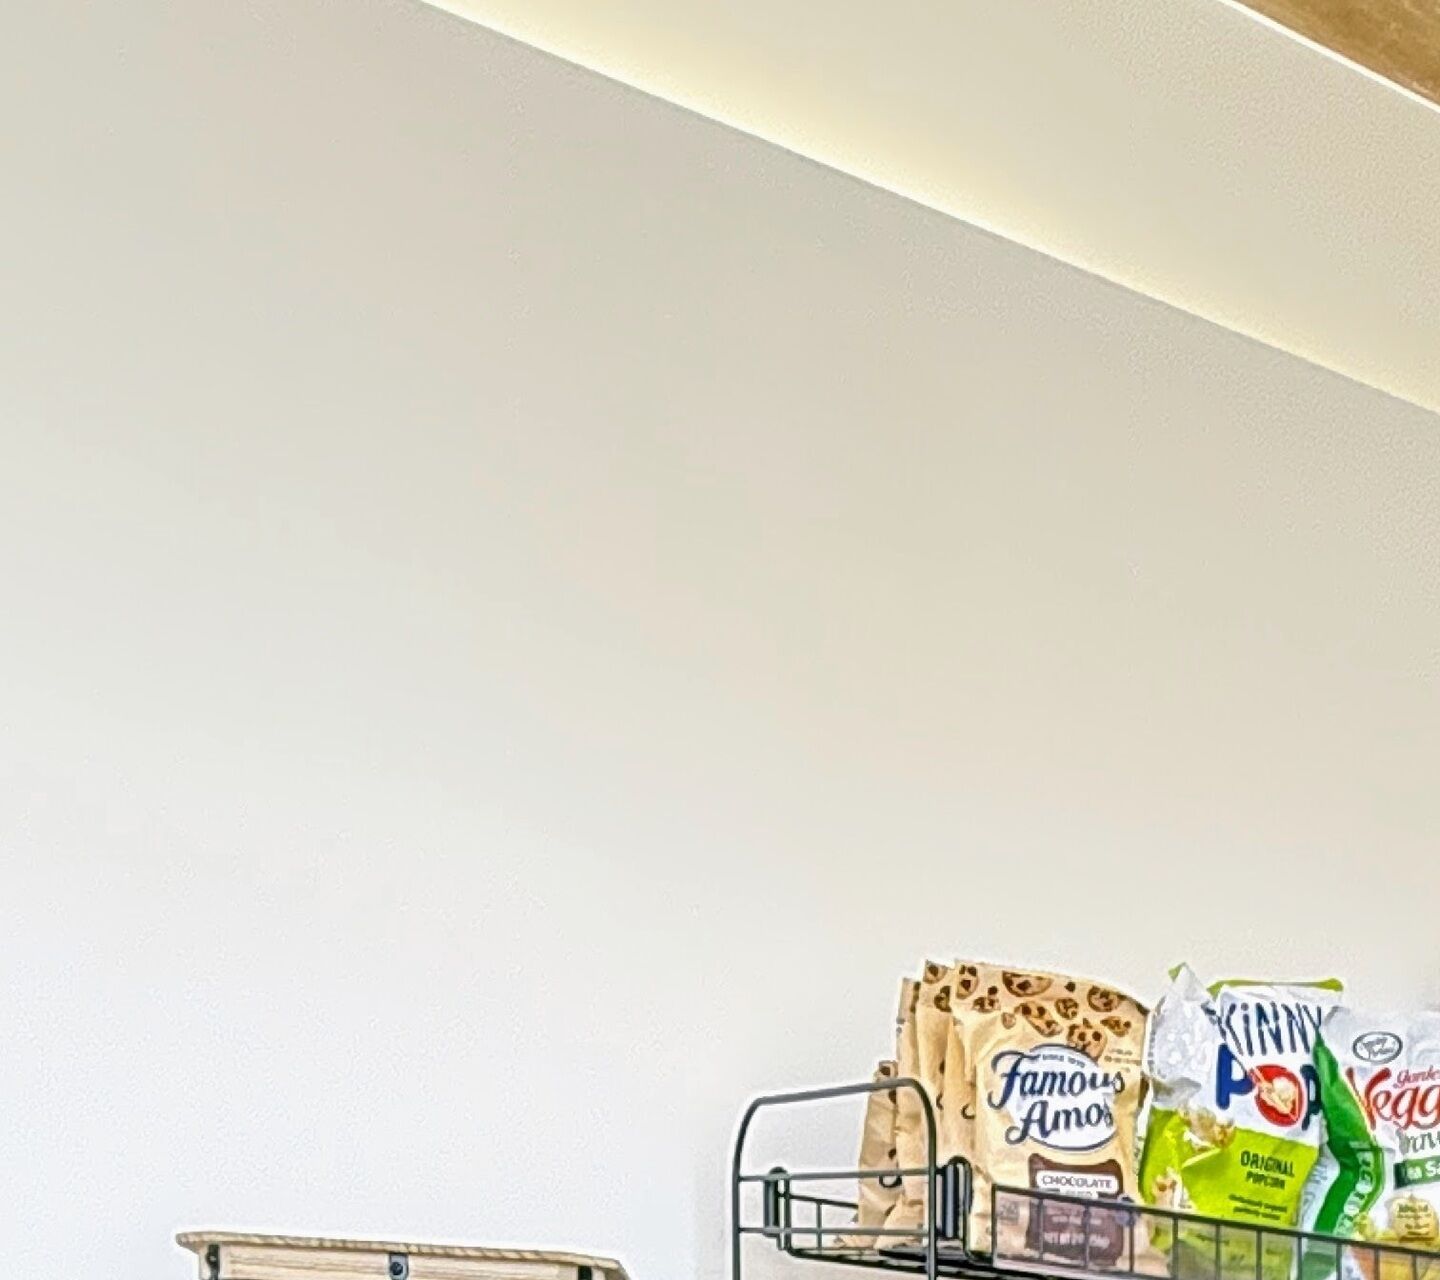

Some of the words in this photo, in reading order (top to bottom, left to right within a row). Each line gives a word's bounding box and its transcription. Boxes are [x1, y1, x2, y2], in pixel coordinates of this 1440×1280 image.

[987, 1050, 1126, 1110] Famous
[1005, 1100, 1114, 1145] Amos
[1042, 1174, 1113, 1190] CHOCOLATE
[1240, 1151, 1295, 1178] ORIGINAL
